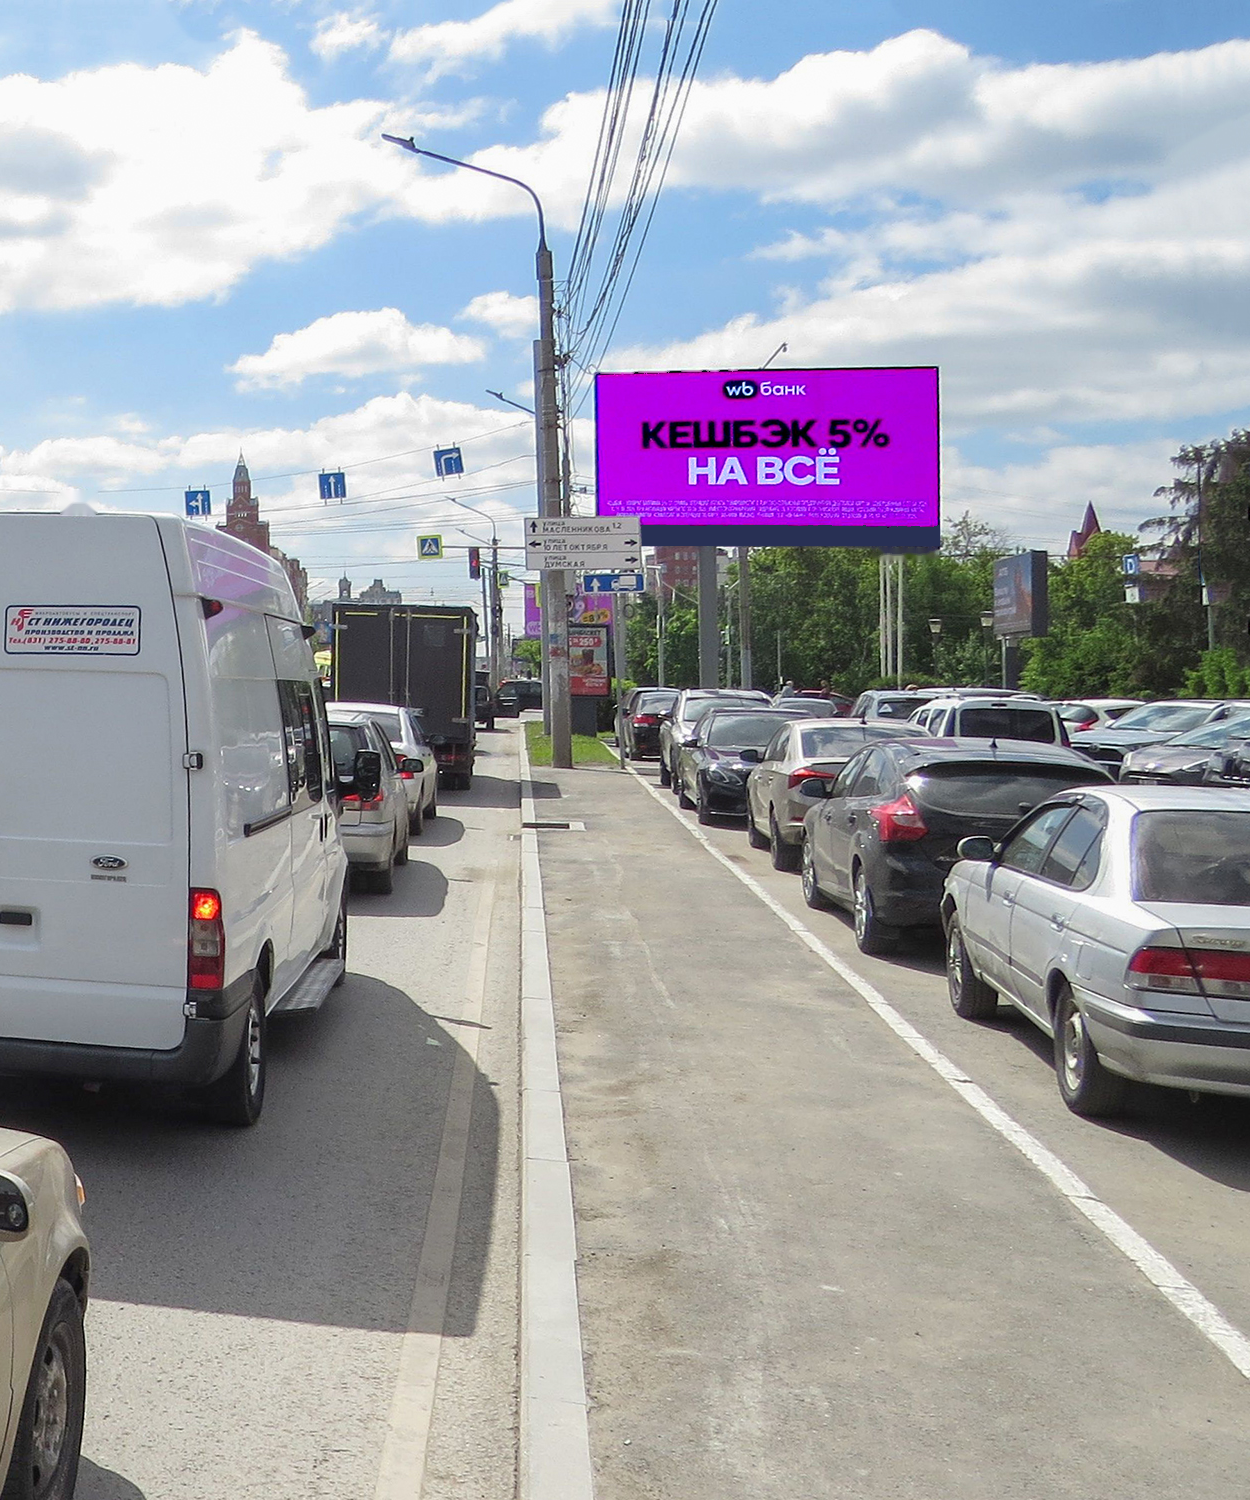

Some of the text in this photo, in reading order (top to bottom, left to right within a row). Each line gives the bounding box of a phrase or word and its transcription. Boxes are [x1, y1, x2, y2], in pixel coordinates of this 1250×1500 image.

[726, 381, 807, 396] wb банк
[641, 419, 890, 449] КЕШБЭК 5%
[687, 448, 840, 486] НА ВСЁ
[542, 526, 611, 534] МАСЛЕННИКОВА
[544, 560, 586, 568] ДУМСКАЯ
[42, 617, 135, 628] НИЖЕГОРОДЕЦ
